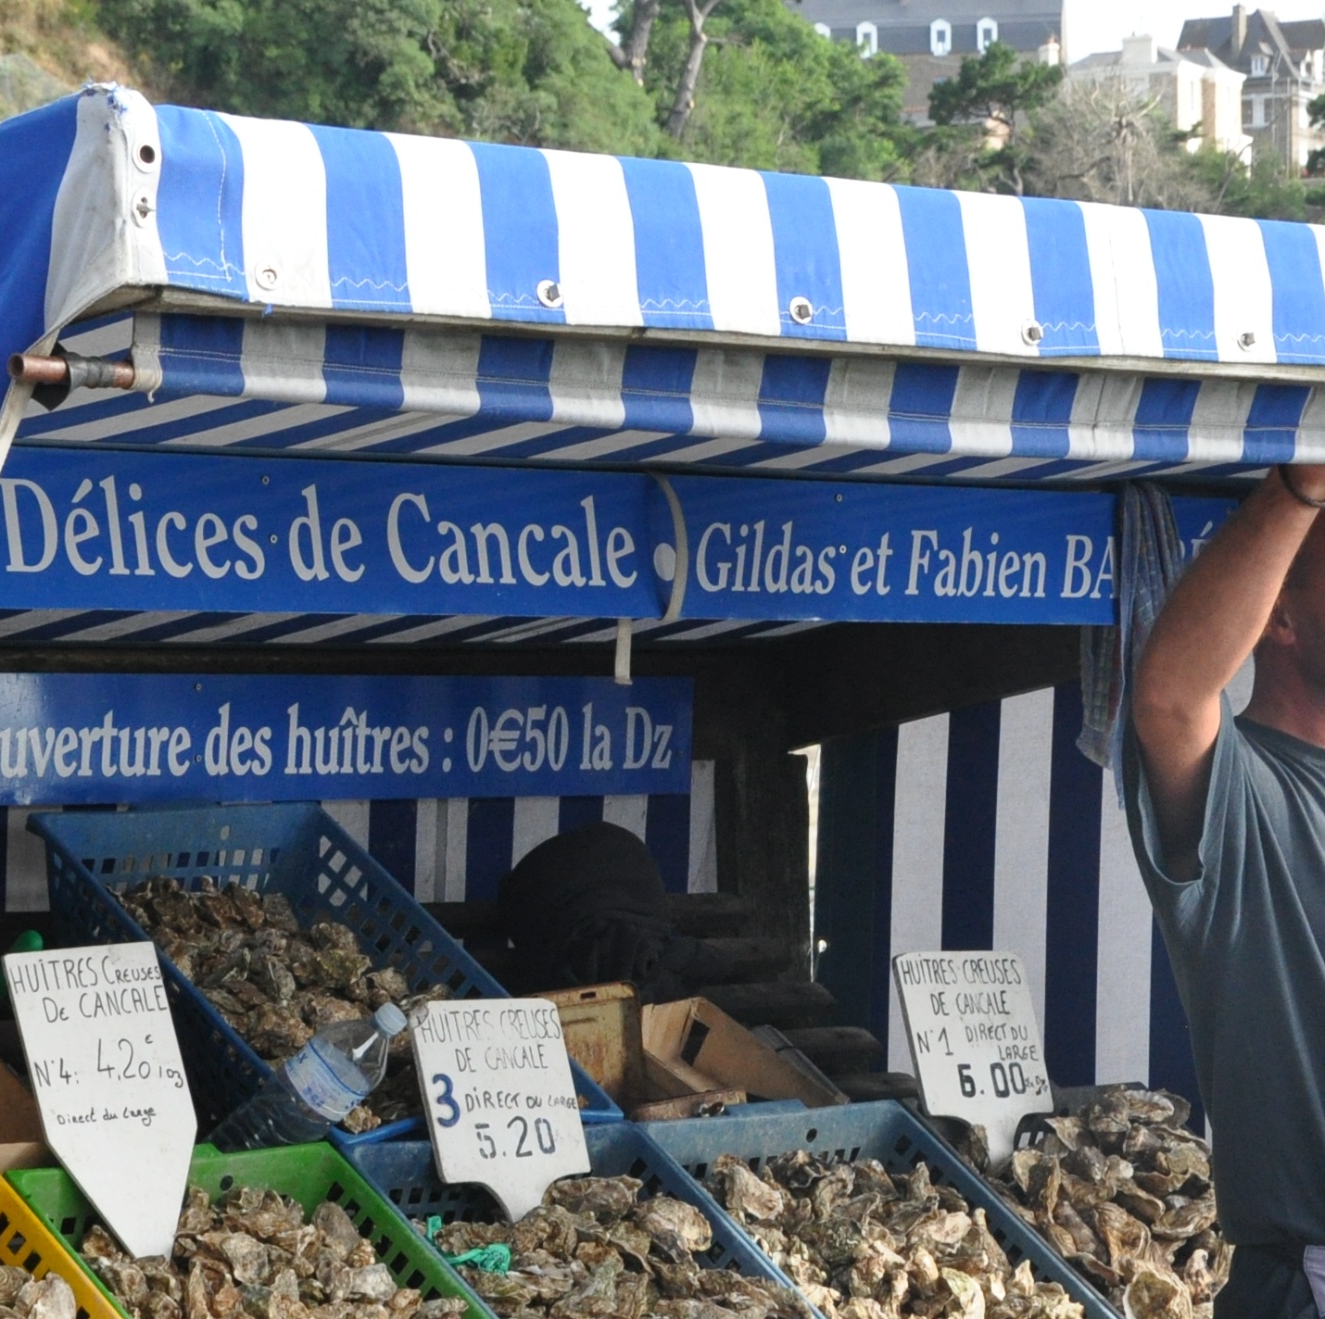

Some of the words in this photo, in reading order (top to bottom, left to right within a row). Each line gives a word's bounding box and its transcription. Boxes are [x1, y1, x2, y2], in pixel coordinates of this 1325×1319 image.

[288, 485, 366, 583] de
[387, 493, 639, 590] Cancale
[695, 520, 837, 595] Gildas
[849, 531, 894, 596] et
[905, 524, 1047, 599] Fabien
[206, 702, 272, 776] des
[284, 702, 430, 774] huîtres
[467, 703, 569, 773] 0€50
[580, 702, 613, 771] la
[623, 708, 673, 771] Dz
[962, 958, 1022, 985] CREUSES
[79, 985, 168, 1018] CANCALE
[930, 991, 950, 1016] DE
[956, 990, 1011, 1015] CANCALE
[500, 1008, 561, 1040] CREUSES
[965, 1022, 1007, 1043] DIRECT
[1011, 1025, 1028, 1041] DU
[455, 1048, 476, 1073] DE
[484, 1044, 549, 1070] CANCALE
[998, 1044, 1039, 1062] LARGE
[103, 1108, 118, 1121] du
[432, 1073, 461, 1128] 3
[474, 1115, 556, 1160] 5.20
